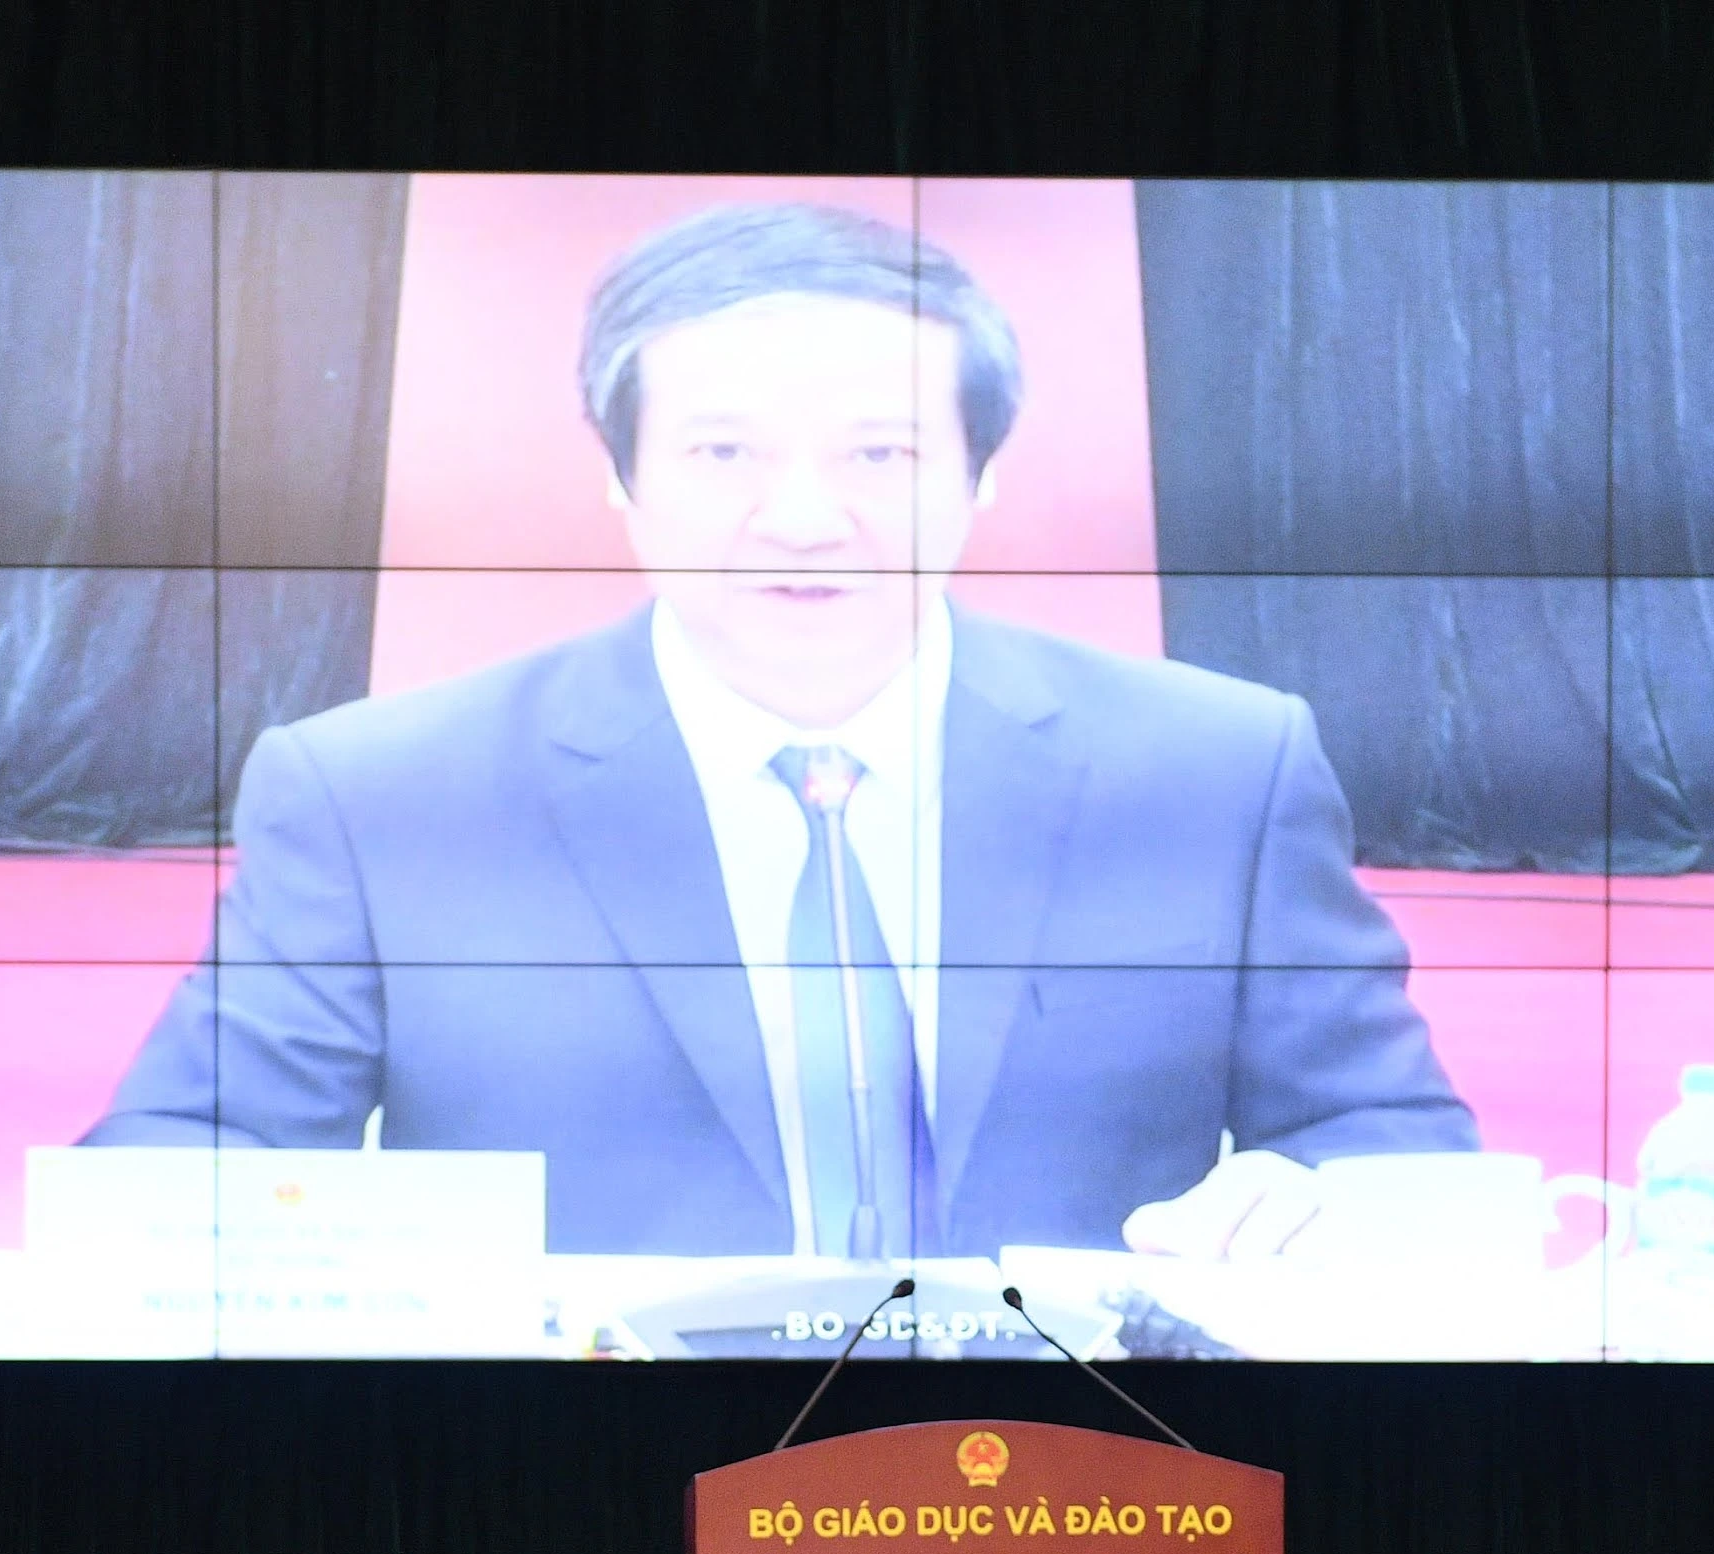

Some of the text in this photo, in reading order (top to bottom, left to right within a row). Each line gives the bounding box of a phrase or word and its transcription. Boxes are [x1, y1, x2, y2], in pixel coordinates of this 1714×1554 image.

[748, 1495, 1232, 1545] BỘ GIÁO DỤC VÀ ĐÀO TẠO
